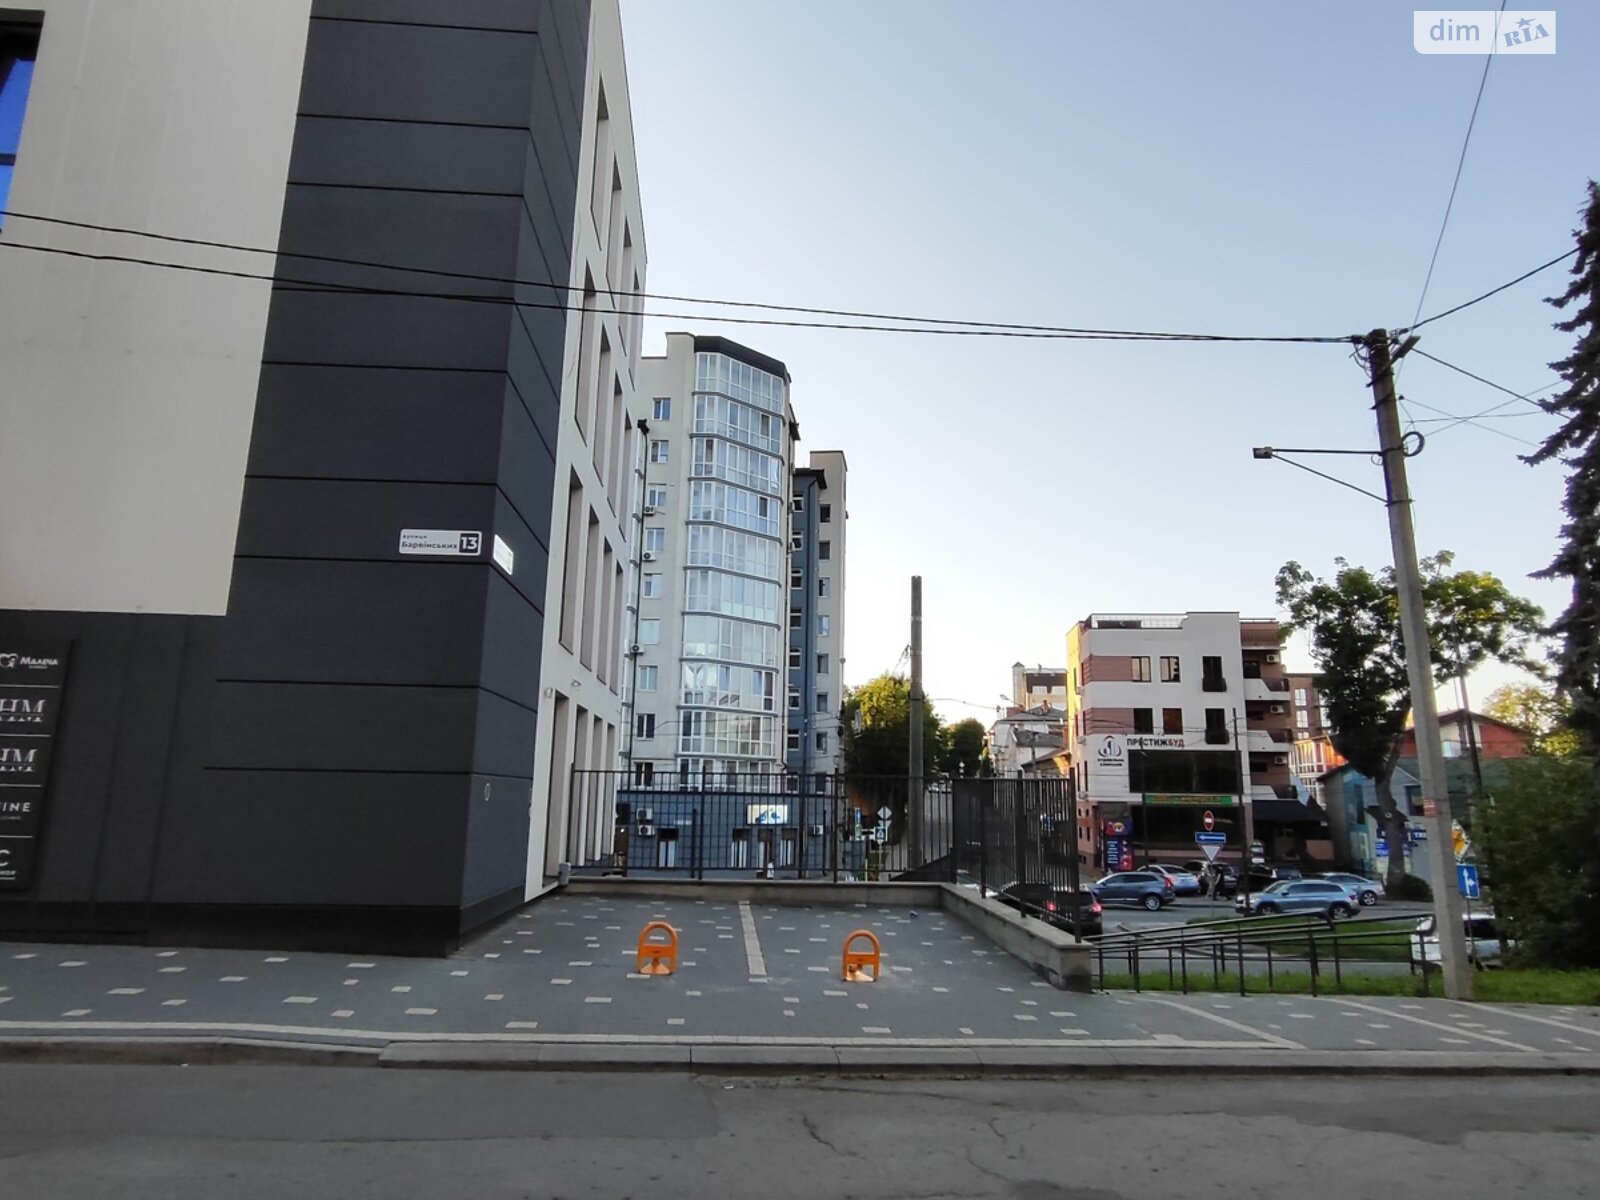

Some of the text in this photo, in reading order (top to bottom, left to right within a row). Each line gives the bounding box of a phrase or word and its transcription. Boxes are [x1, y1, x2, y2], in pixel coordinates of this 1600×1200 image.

[401, 540, 458, 550] Барвінських
[461, 536, 478, 550] 13
[0, 801, 32, 813] INE
